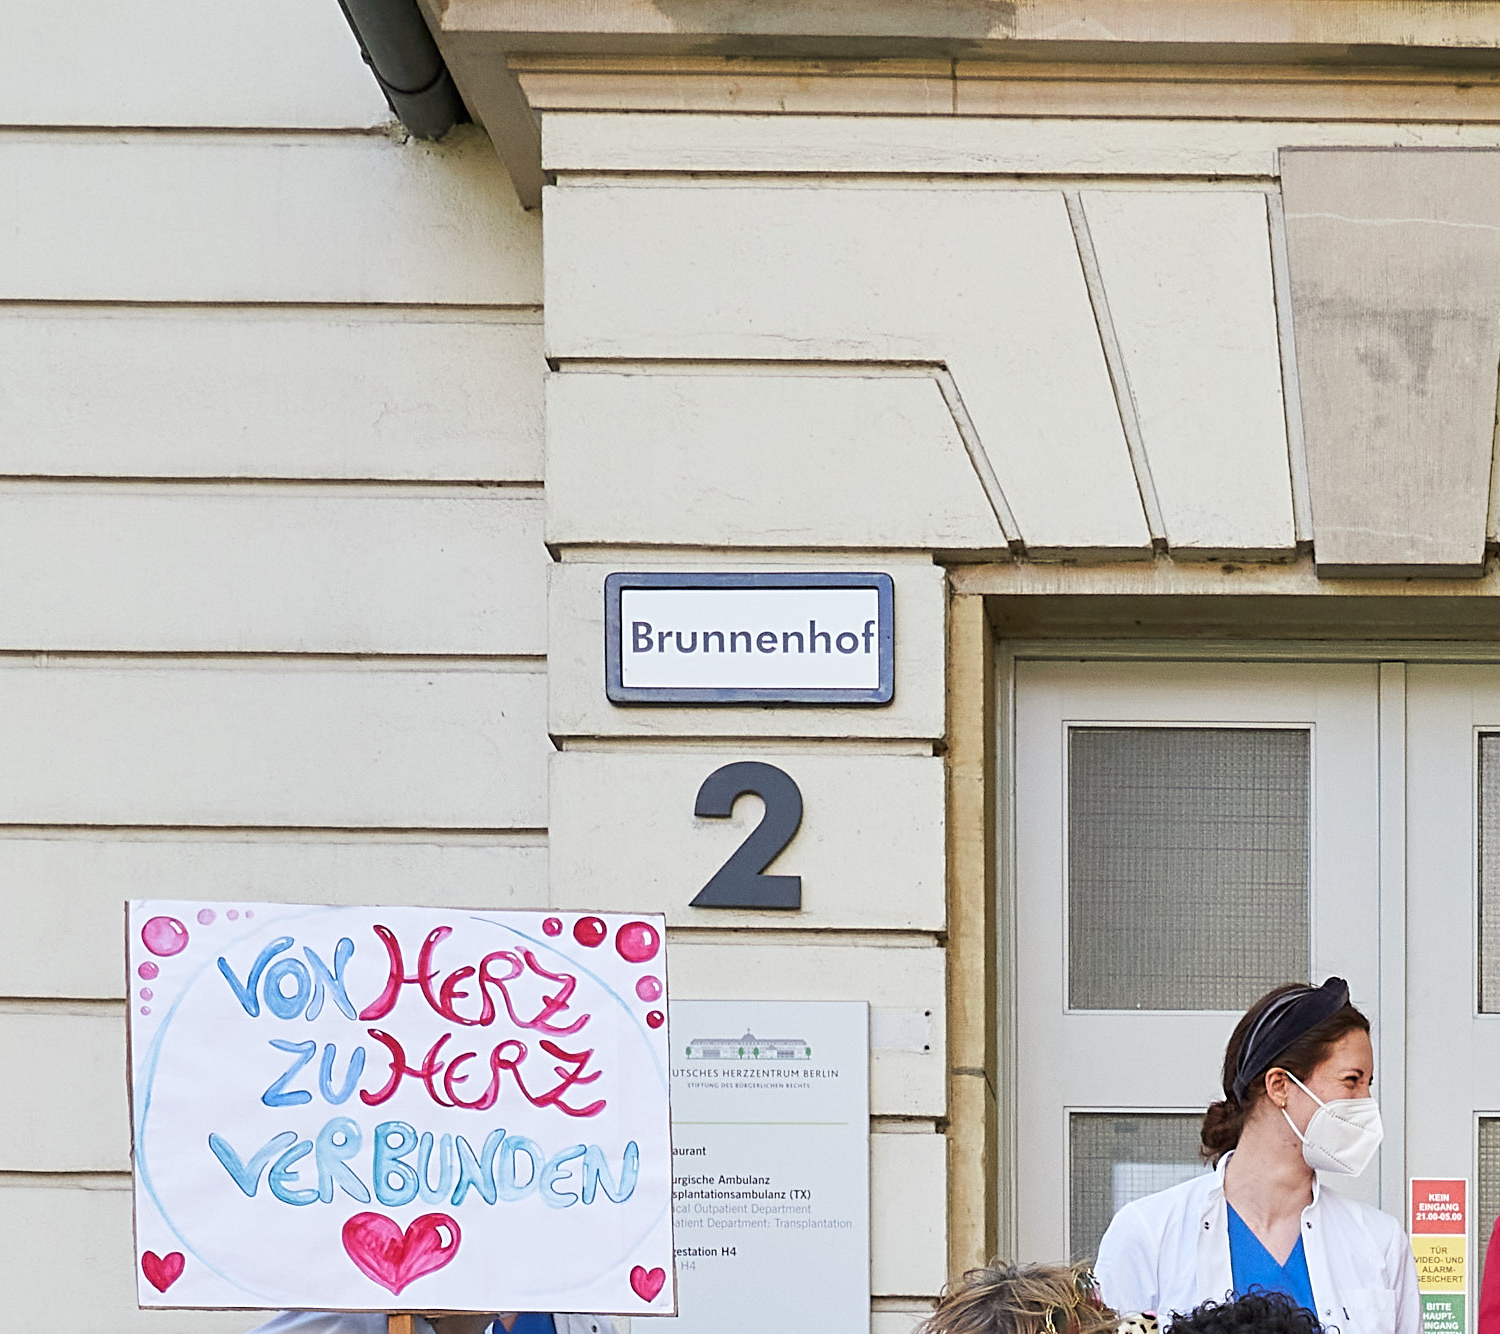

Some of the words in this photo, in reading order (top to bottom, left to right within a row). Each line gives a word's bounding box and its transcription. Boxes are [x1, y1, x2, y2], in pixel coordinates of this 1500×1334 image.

[631, 619, 876, 655] Brunnenhof
[688, 760, 804, 912] 2
[217, 936, 358, 1021] VON
[358, 924, 592, 1038] HERZ
[260, 1038, 366, 1107] ZU
[359, 1028, 607, 1118] HERZ
[672, 1069, 719, 1078] UTSCHES
[722, 1069, 800, 1078] HERZZENTRUM
[803, 1069, 839, 1078] BERLIN
[208, 1116, 640, 1208] VERBUNDEN
[718, 1174, 771, 1185] Ambulanz
[789, 1189, 811, 1201] (TX)
[1429, 1193, 1450, 1202] KEIN
[693, 1202, 748, 1216] Outpatient
[751, 1203, 811, 1217] Department
[1419, 1203, 1460, 1211] EINGANG
[1416, 1213, 1462, 1221] 21.00-05.00
[774, 1217, 853, 1230] Transplantation
[721, 1246, 737, 1257] H4
[1430, 1245, 1448, 1254] TÜR
[1426, 1303, 1452, 1311] BITTE
[1423, 1312, 1456, 1320] HAUPT-
